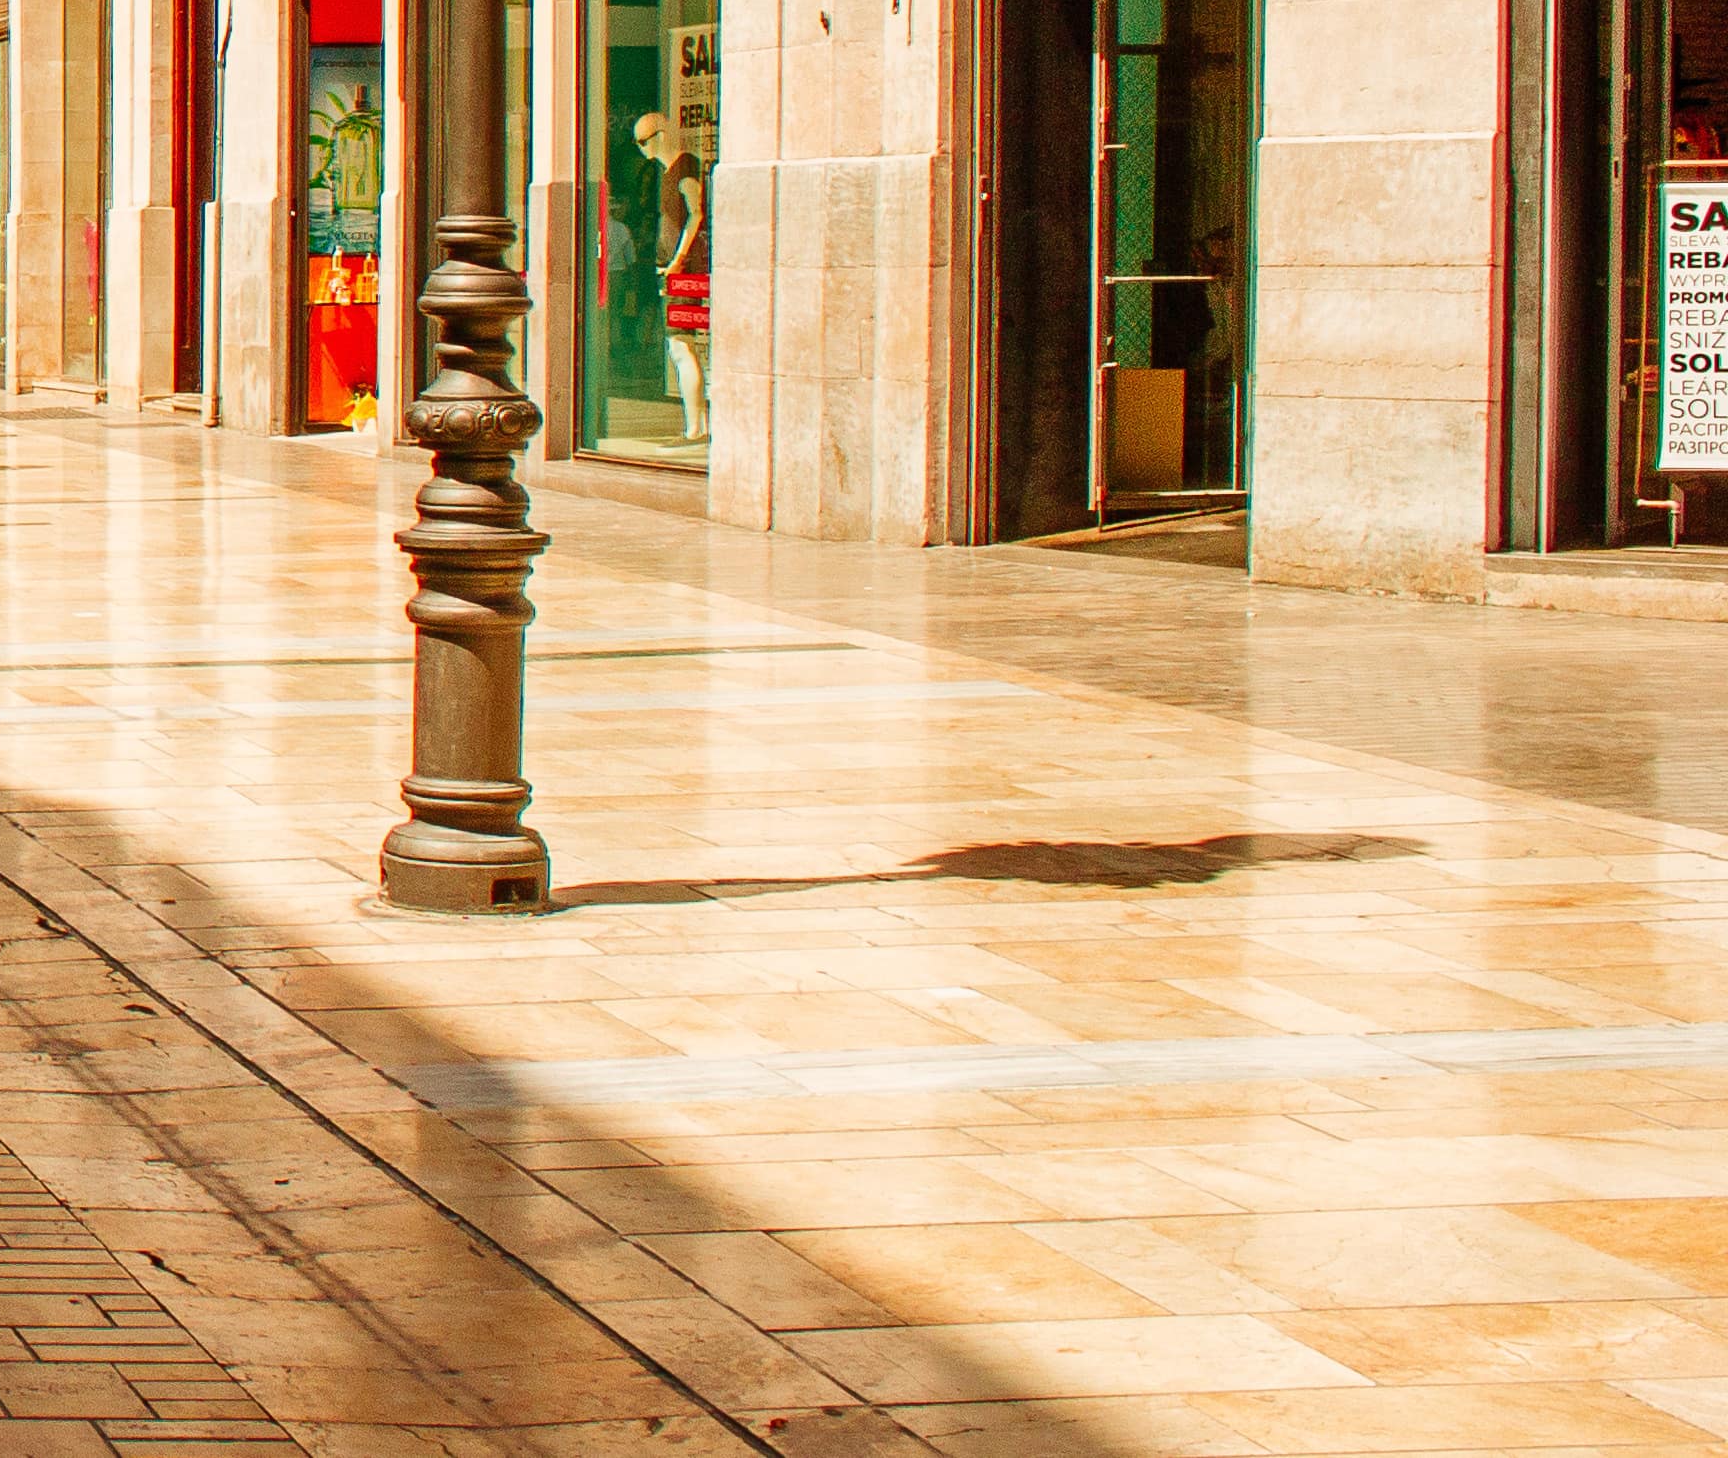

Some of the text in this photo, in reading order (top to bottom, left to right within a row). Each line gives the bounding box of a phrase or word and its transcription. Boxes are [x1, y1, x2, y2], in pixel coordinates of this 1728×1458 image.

[1670, 201, 1728, 232] SA
[1669, 235, 1720, 247] SLEVA
[1670, 353, 1728, 373] SOL
[1670, 398, 1728, 419] SOL
